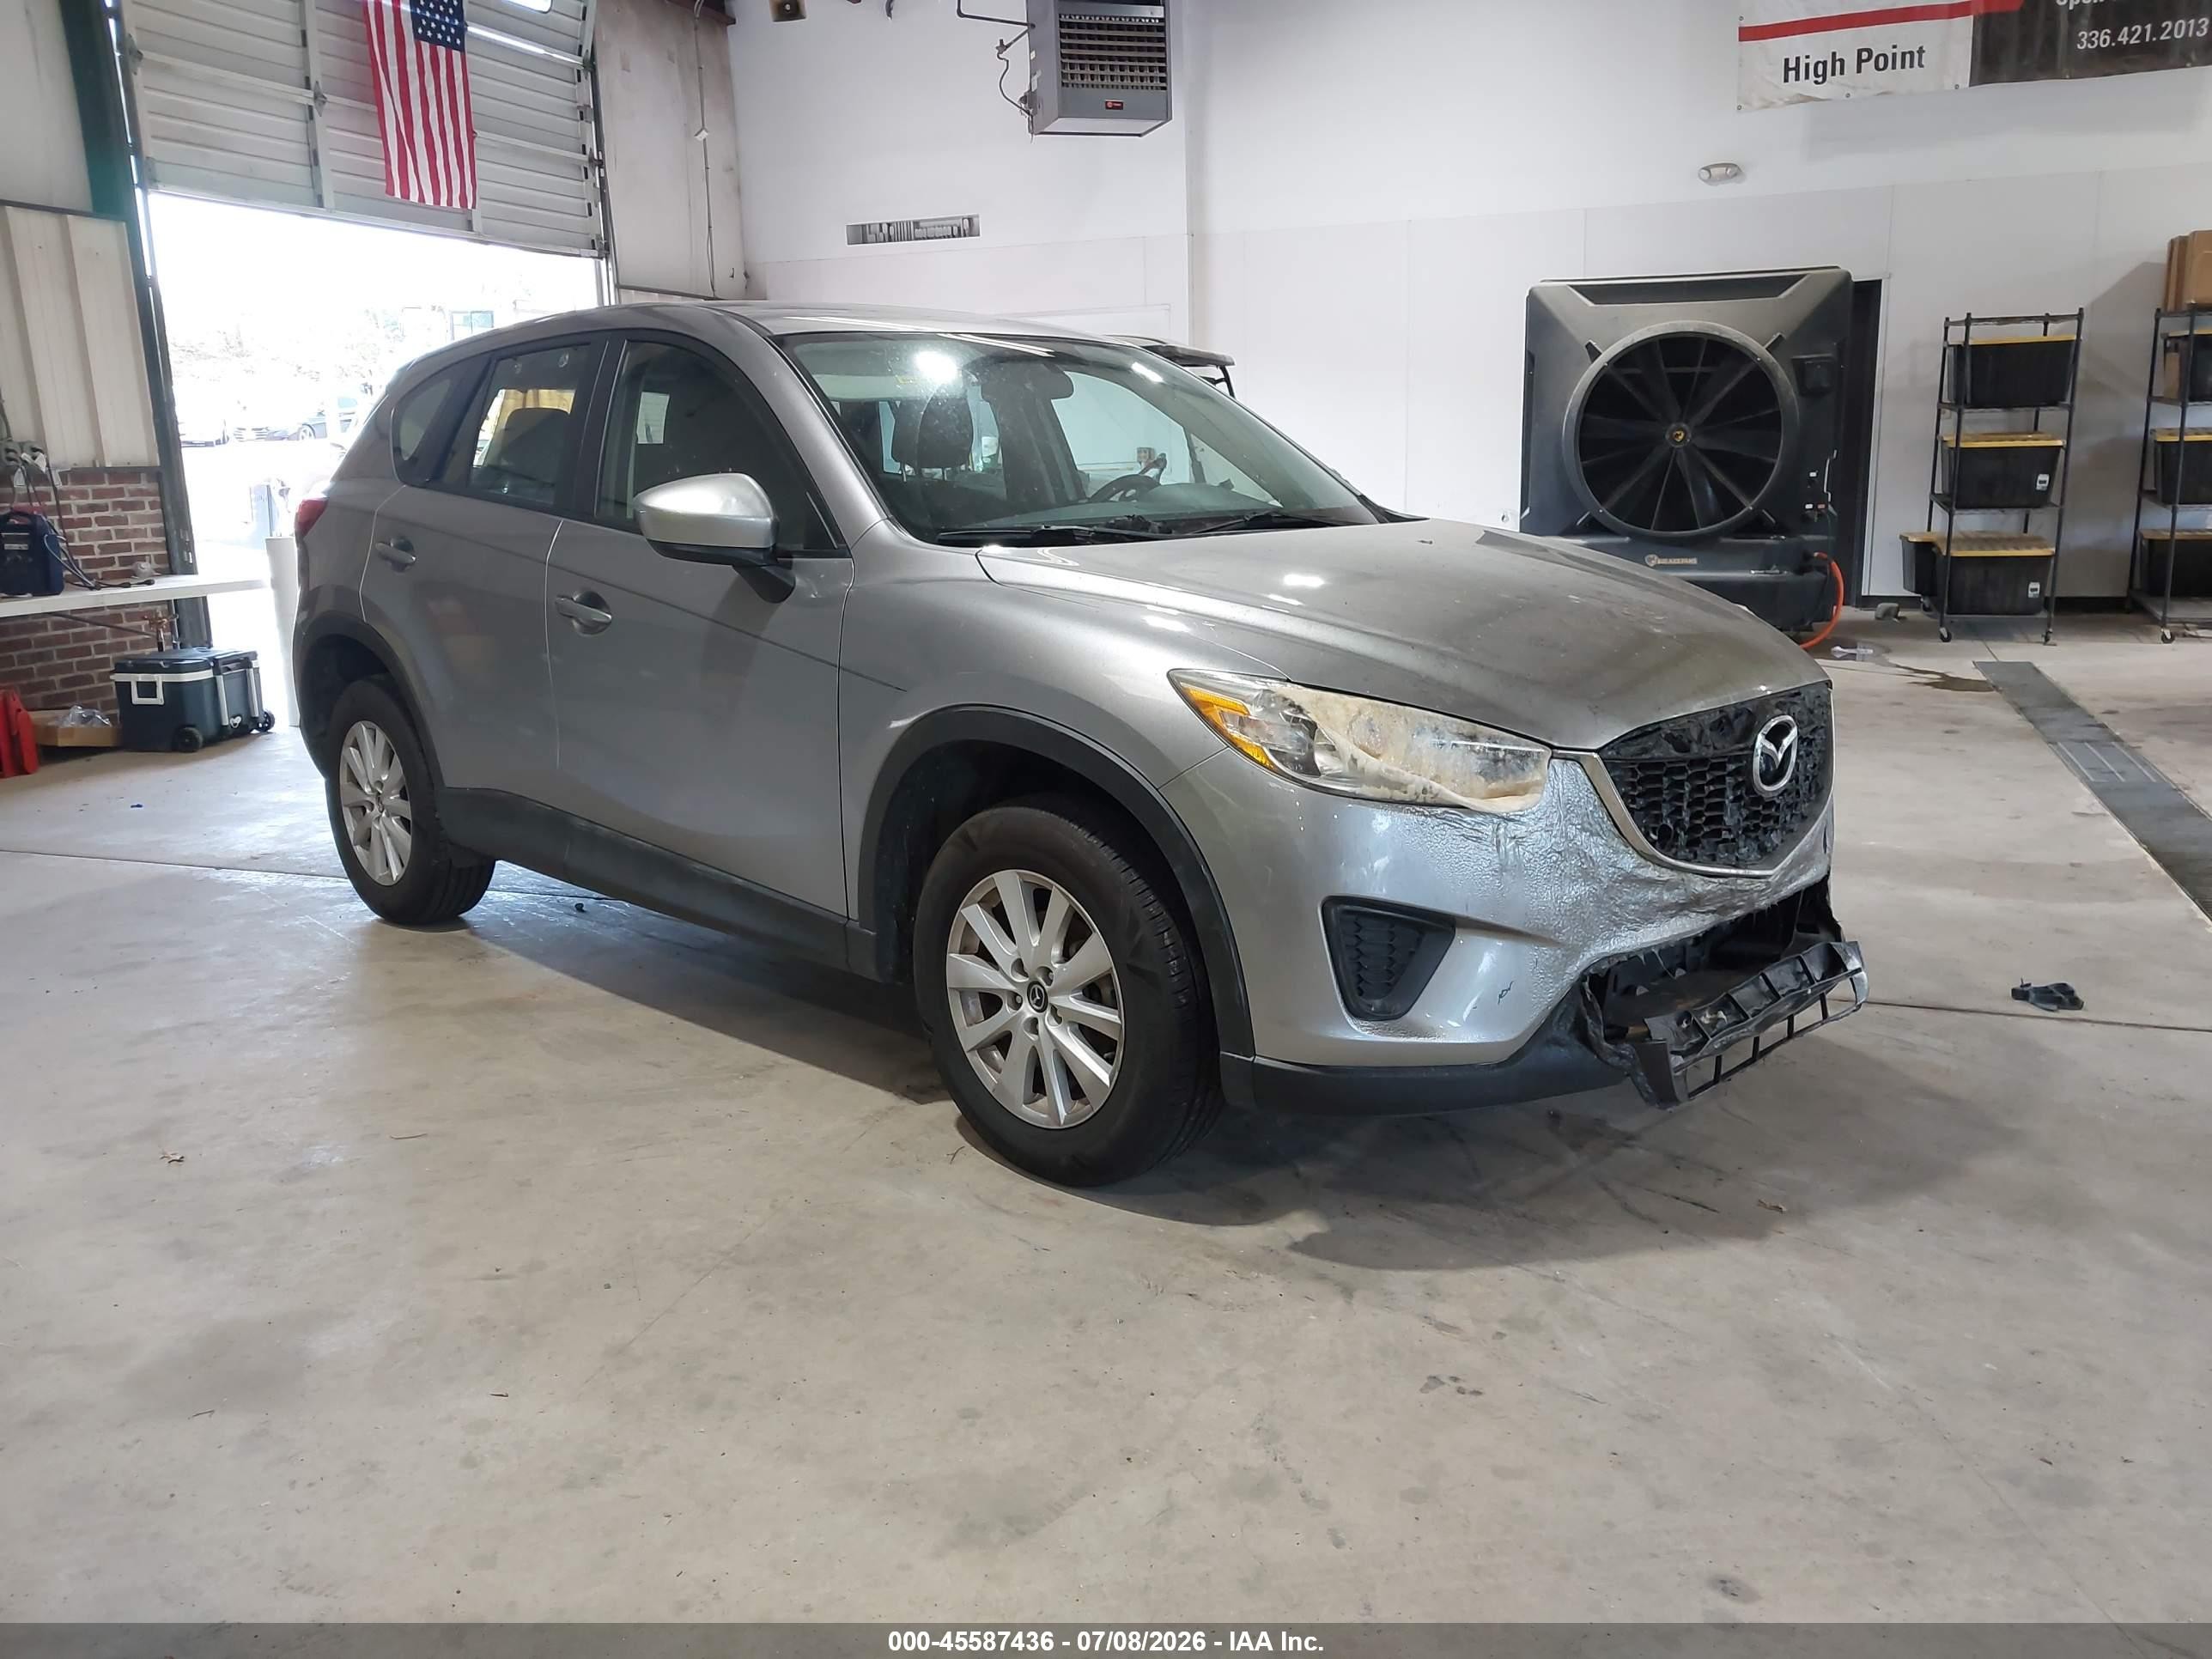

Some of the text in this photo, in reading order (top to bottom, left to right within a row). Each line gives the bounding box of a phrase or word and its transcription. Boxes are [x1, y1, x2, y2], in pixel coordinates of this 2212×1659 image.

[2076, 17, 2209, 50] 336.421.2013
[1783, 44, 1925, 85] High Point
